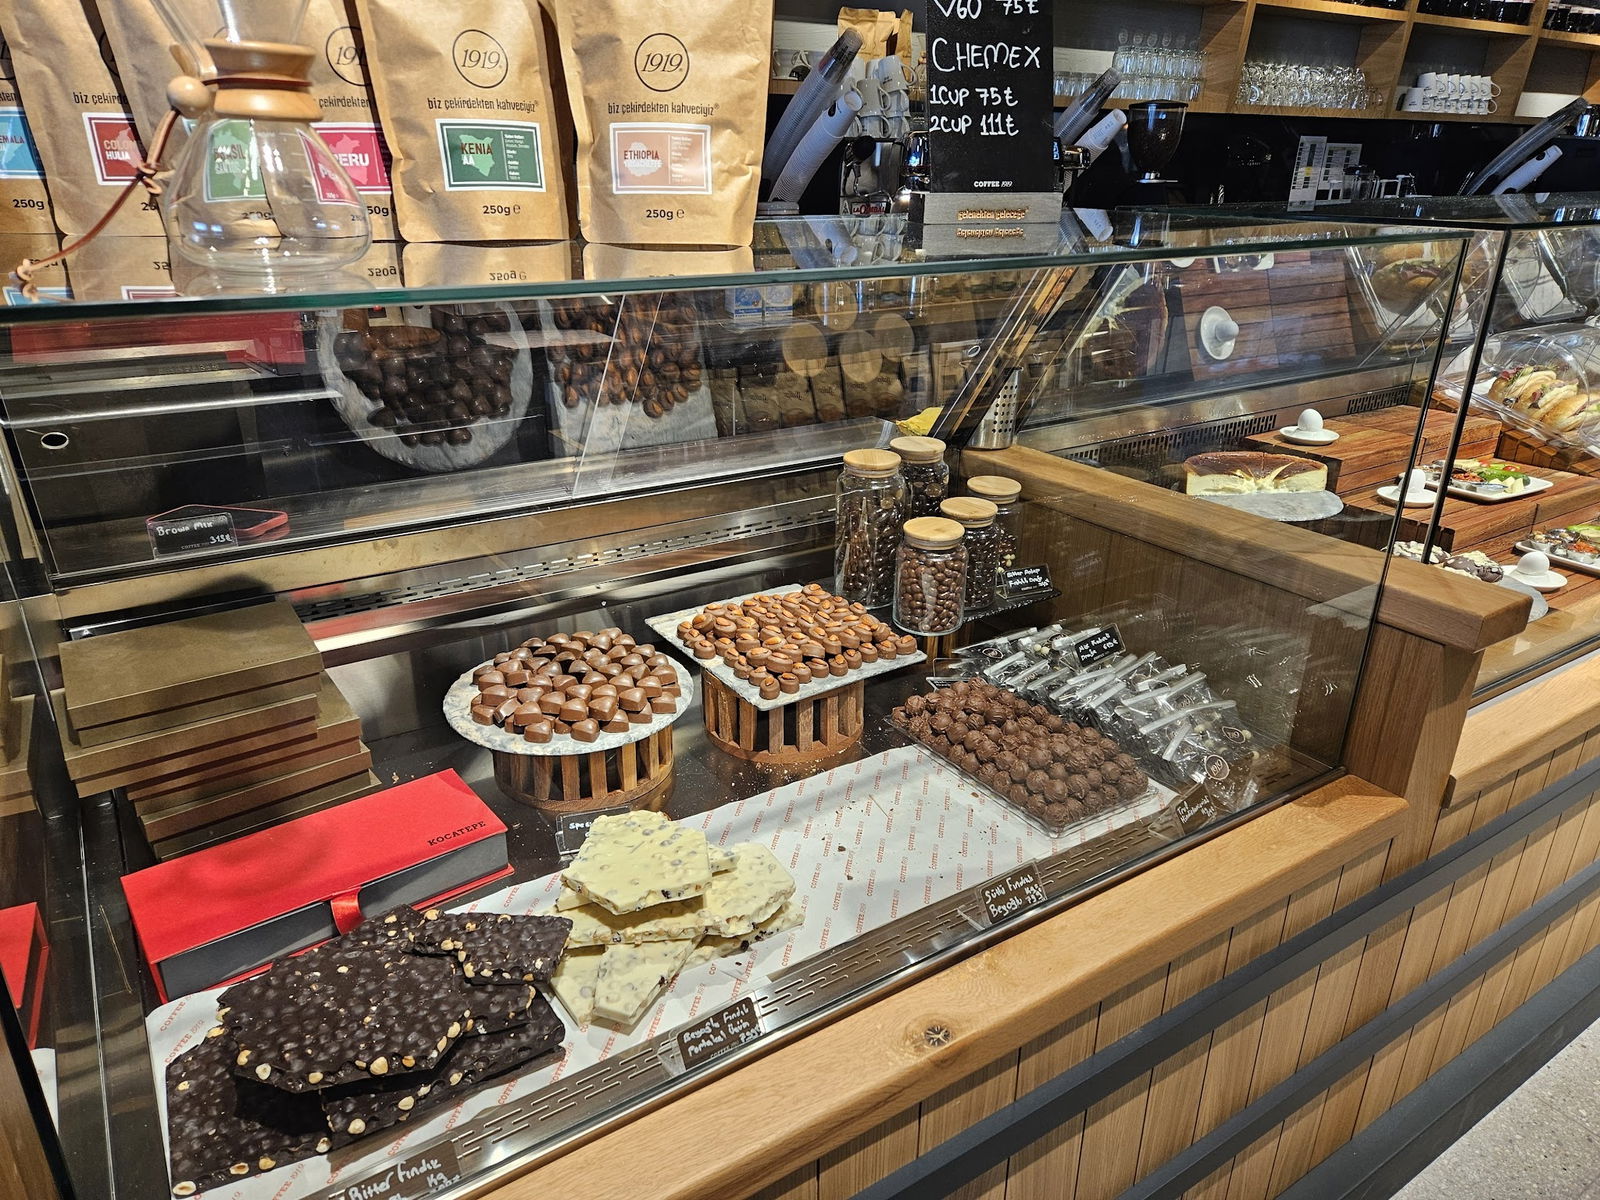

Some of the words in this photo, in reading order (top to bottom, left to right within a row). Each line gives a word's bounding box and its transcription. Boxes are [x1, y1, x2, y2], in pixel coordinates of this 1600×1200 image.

[461, 48, 502, 69] 1919
[641, 52, 684, 72] 1919
[73, 92, 89, 104] biz
[428, 97, 441, 110] biz
[444, 97, 495, 110] çekirdekten
[608, 103, 620, 114] biz
[622, 102, 669, 114] çekirdekten
[460, 142, 494, 155] KENIA
[462, 155, 475, 165] AA
[623, 150, 660, 160] ETHIOPIA
[973, 180, 1000, 188] COFFEE
[13, 199, 45, 210] 250g
[367, 206, 390, 217] 50g
[482, 205, 511, 216] 250g
[646, 209, 673, 220] 250g
[427, 821, 486, 846] KOCATEPE
